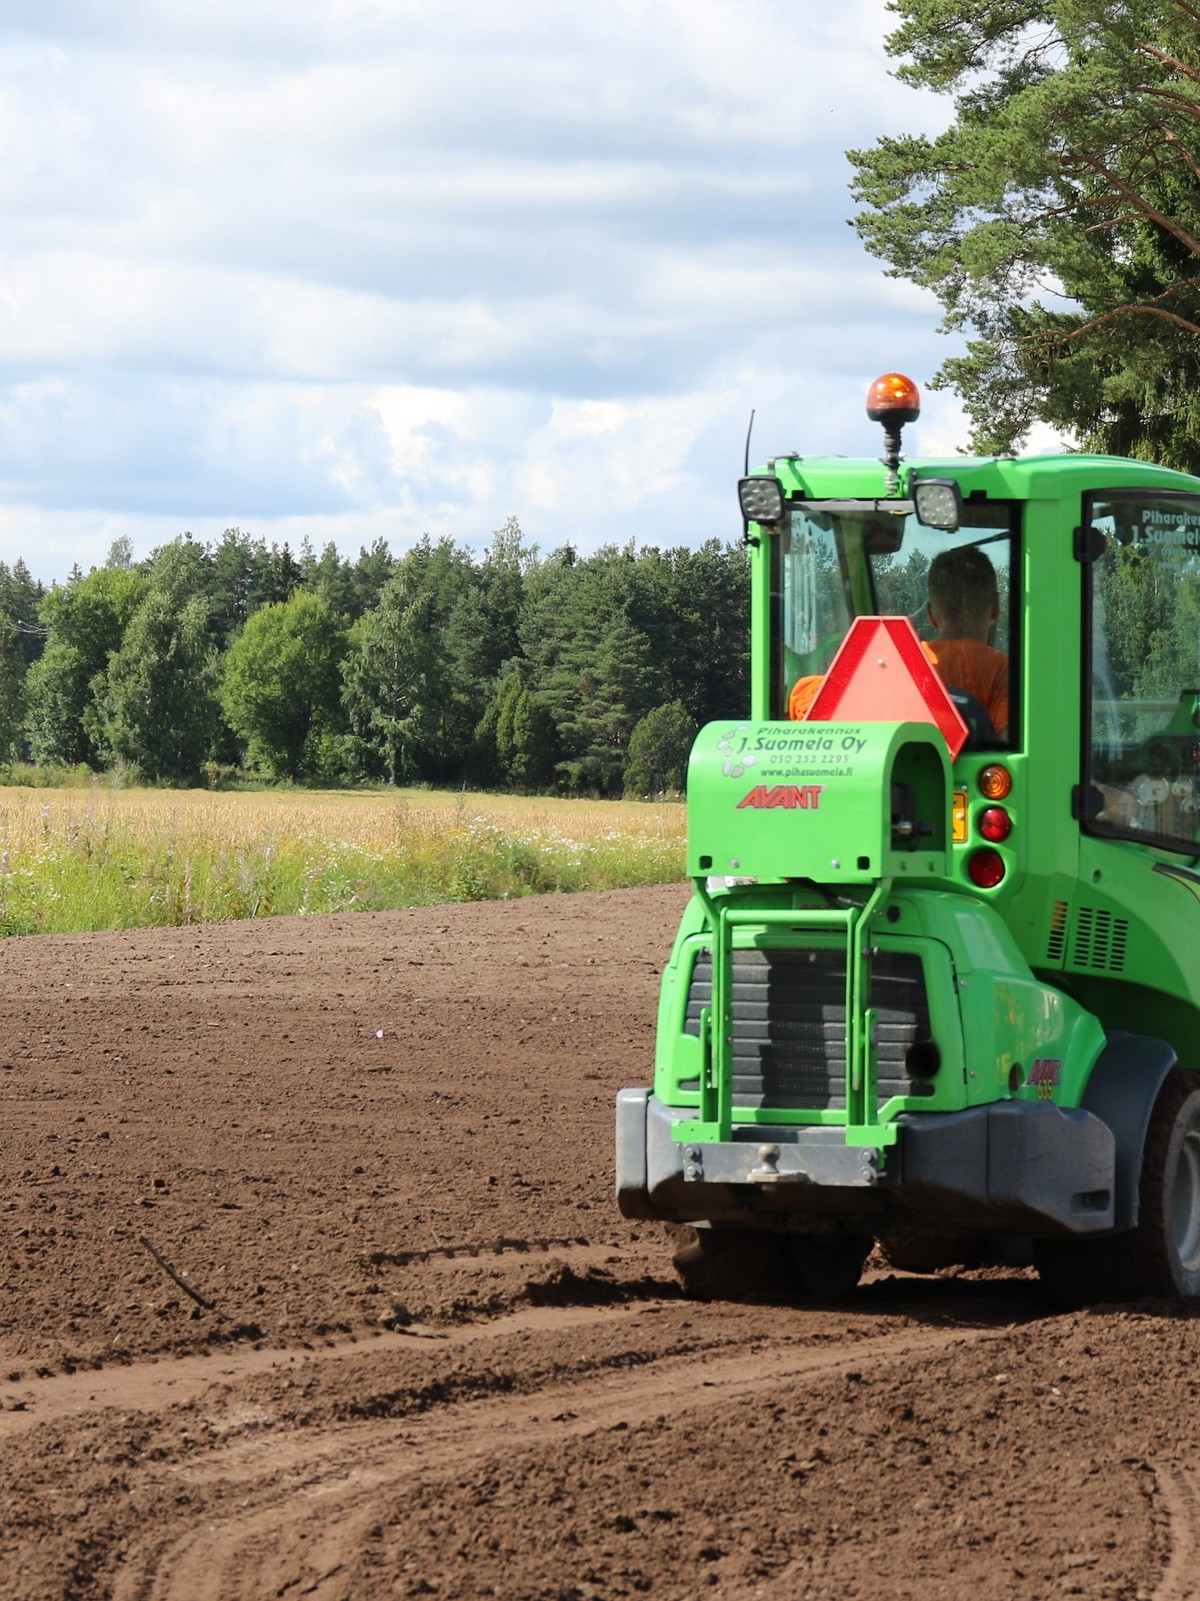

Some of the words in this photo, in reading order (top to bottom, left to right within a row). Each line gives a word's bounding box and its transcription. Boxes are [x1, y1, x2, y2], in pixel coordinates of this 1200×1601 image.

[757, 727, 861, 735] Piharakennus
[737, 737, 833, 754] J.Suomela
[841, 736, 867, 754] Oy
[769, 755, 792, 764] 050
[795, 755, 816, 764] 353
[821, 755, 849, 764] 2295
[735, 784, 823, 809] AVANT
